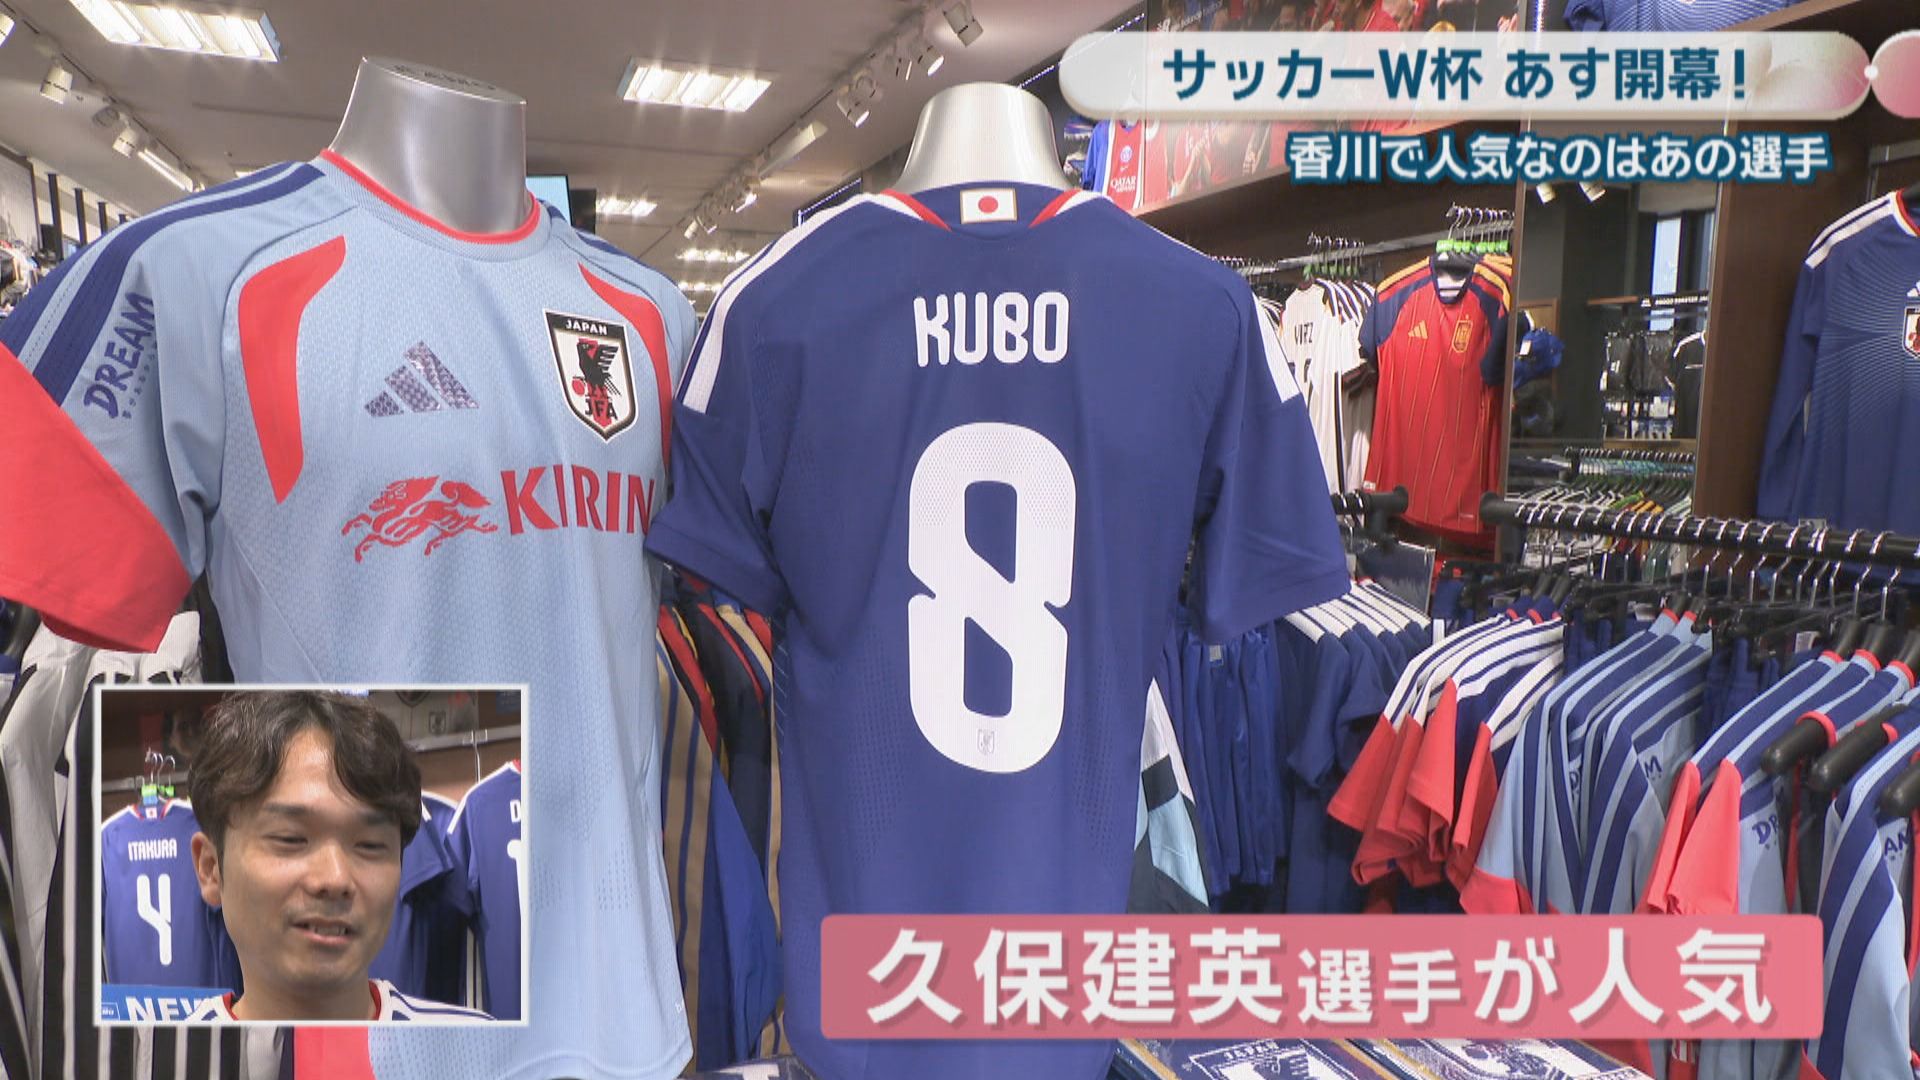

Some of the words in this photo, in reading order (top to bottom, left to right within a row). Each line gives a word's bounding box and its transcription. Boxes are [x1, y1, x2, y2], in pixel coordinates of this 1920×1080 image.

[83, 292, 155, 419] DREAM
[565, 319, 608, 336] JAPAN
[913, 291, 1070, 367] KUBO
[584, 398, 618, 420] JFA
[500, 464, 655, 536] KIRIN
[908, 422, 1076, 773] 8
[128, 838, 178, 862] ITAKURA
[136, 873, 172, 966] 4
